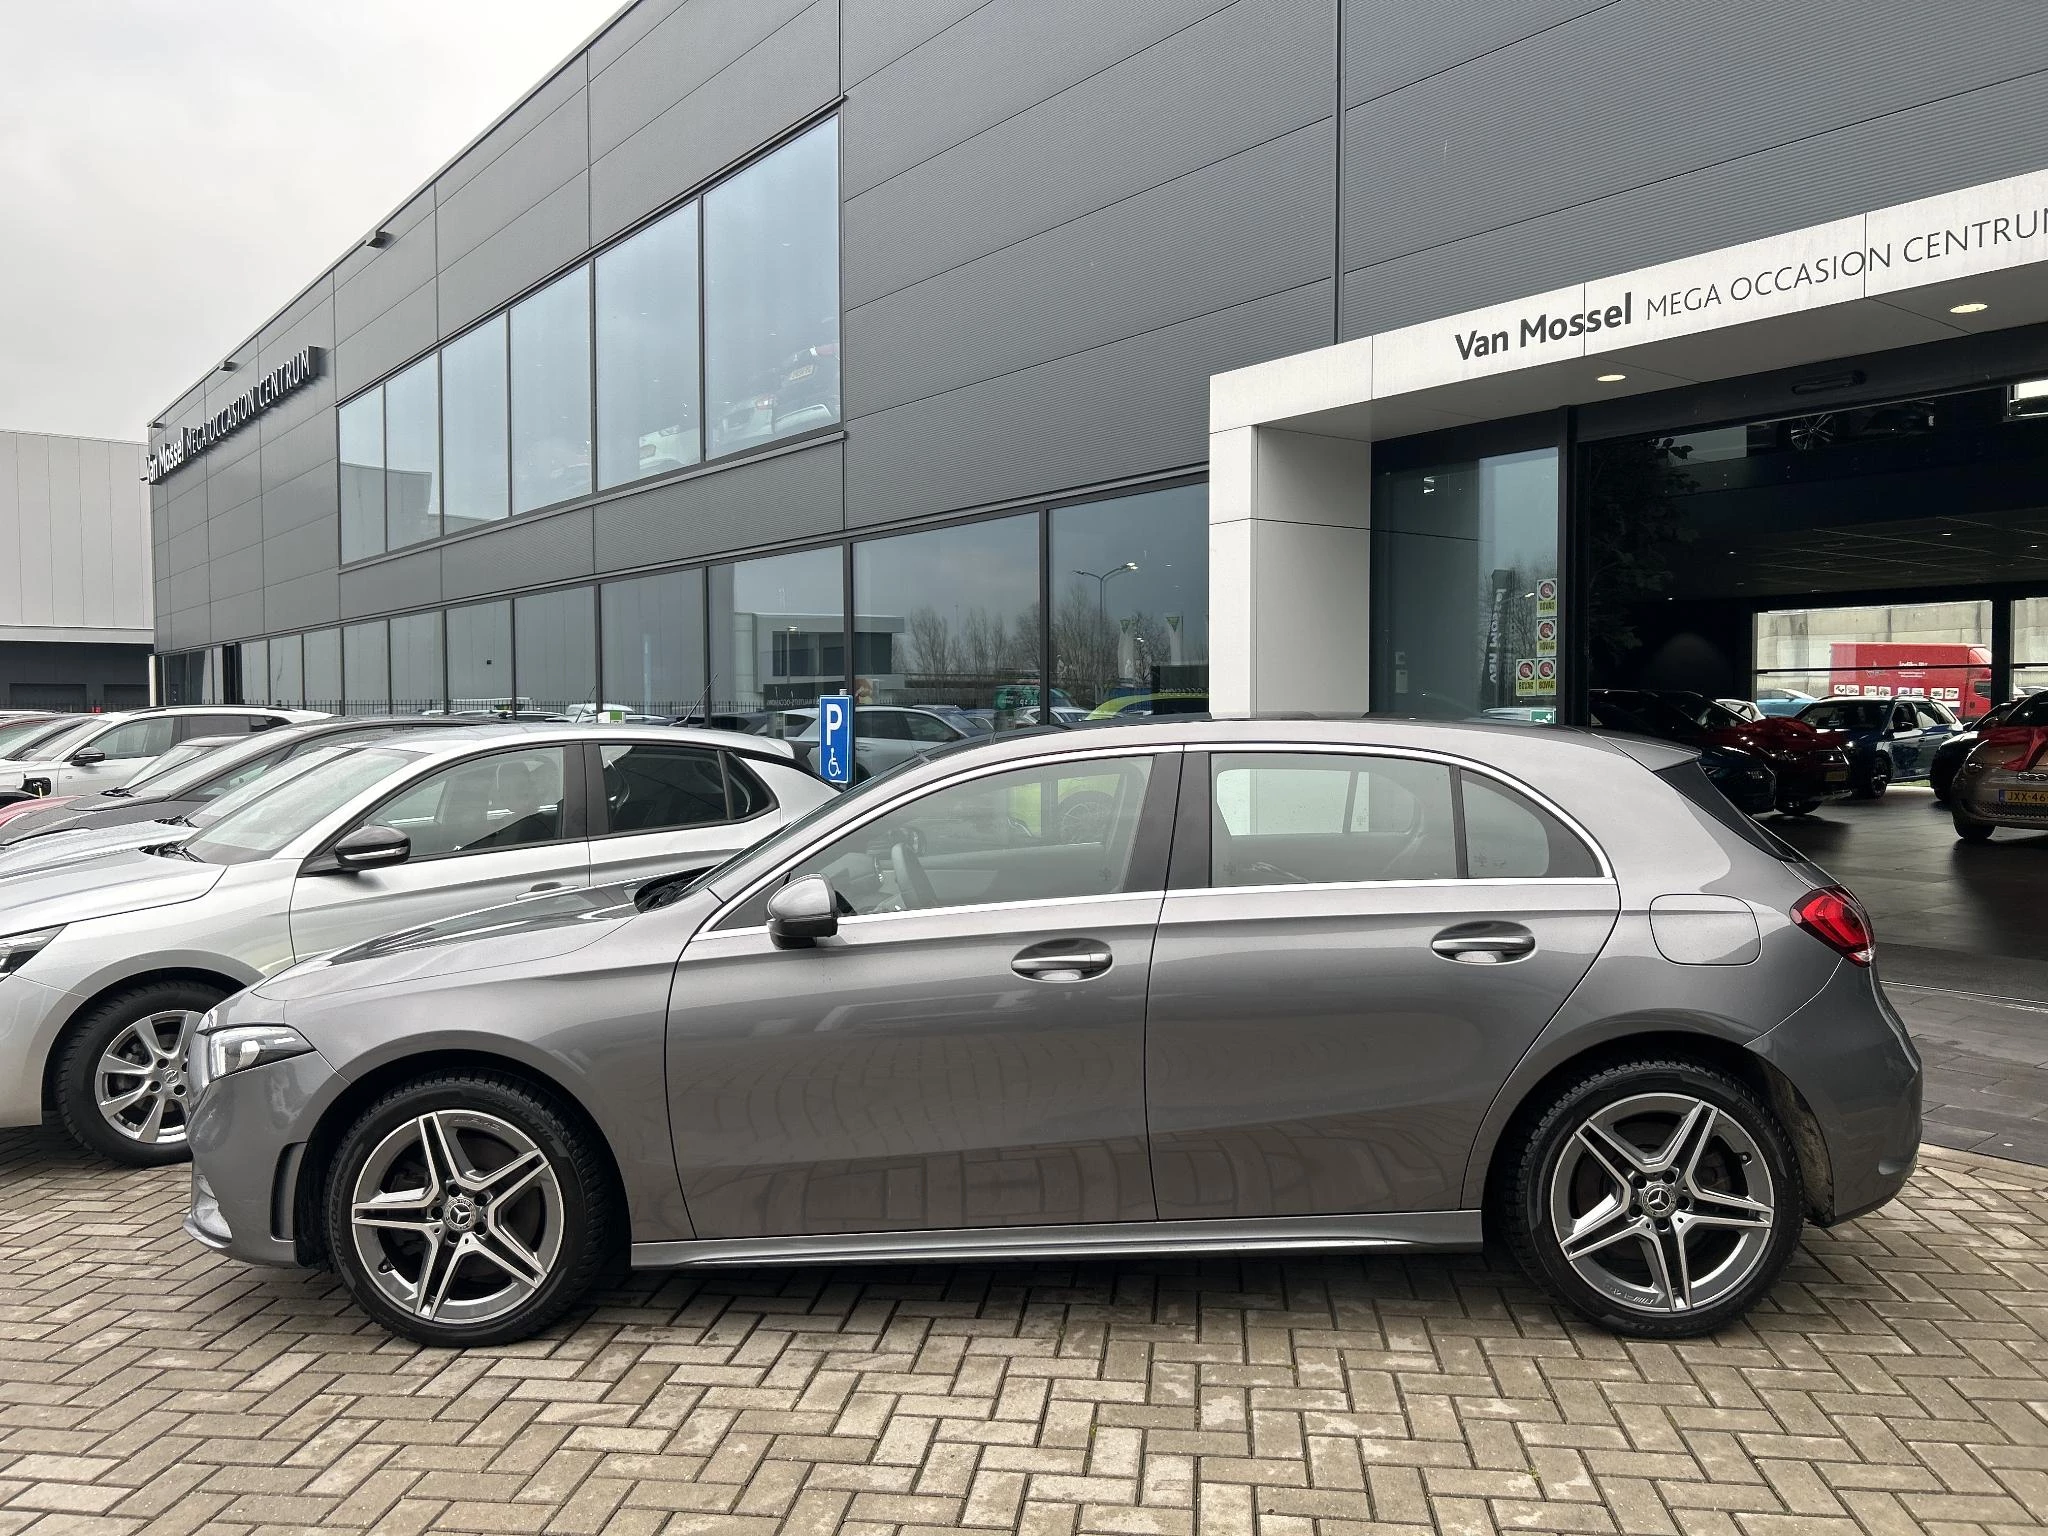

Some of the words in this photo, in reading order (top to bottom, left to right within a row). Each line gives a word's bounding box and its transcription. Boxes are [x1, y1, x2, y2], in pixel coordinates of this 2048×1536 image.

[1454, 329, 1509, 361] Van
[1519, 291, 1632, 348] Mossel
[1646, 283, 1722, 321] MEGA
[1730, 243, 1891, 301] OCCASION
[158, 427, 184, 477] Mossel
[209, 388, 255, 441] OCCASION
[259, 345, 310, 408] CENTRUM
[826, 703, 842, 746] P
